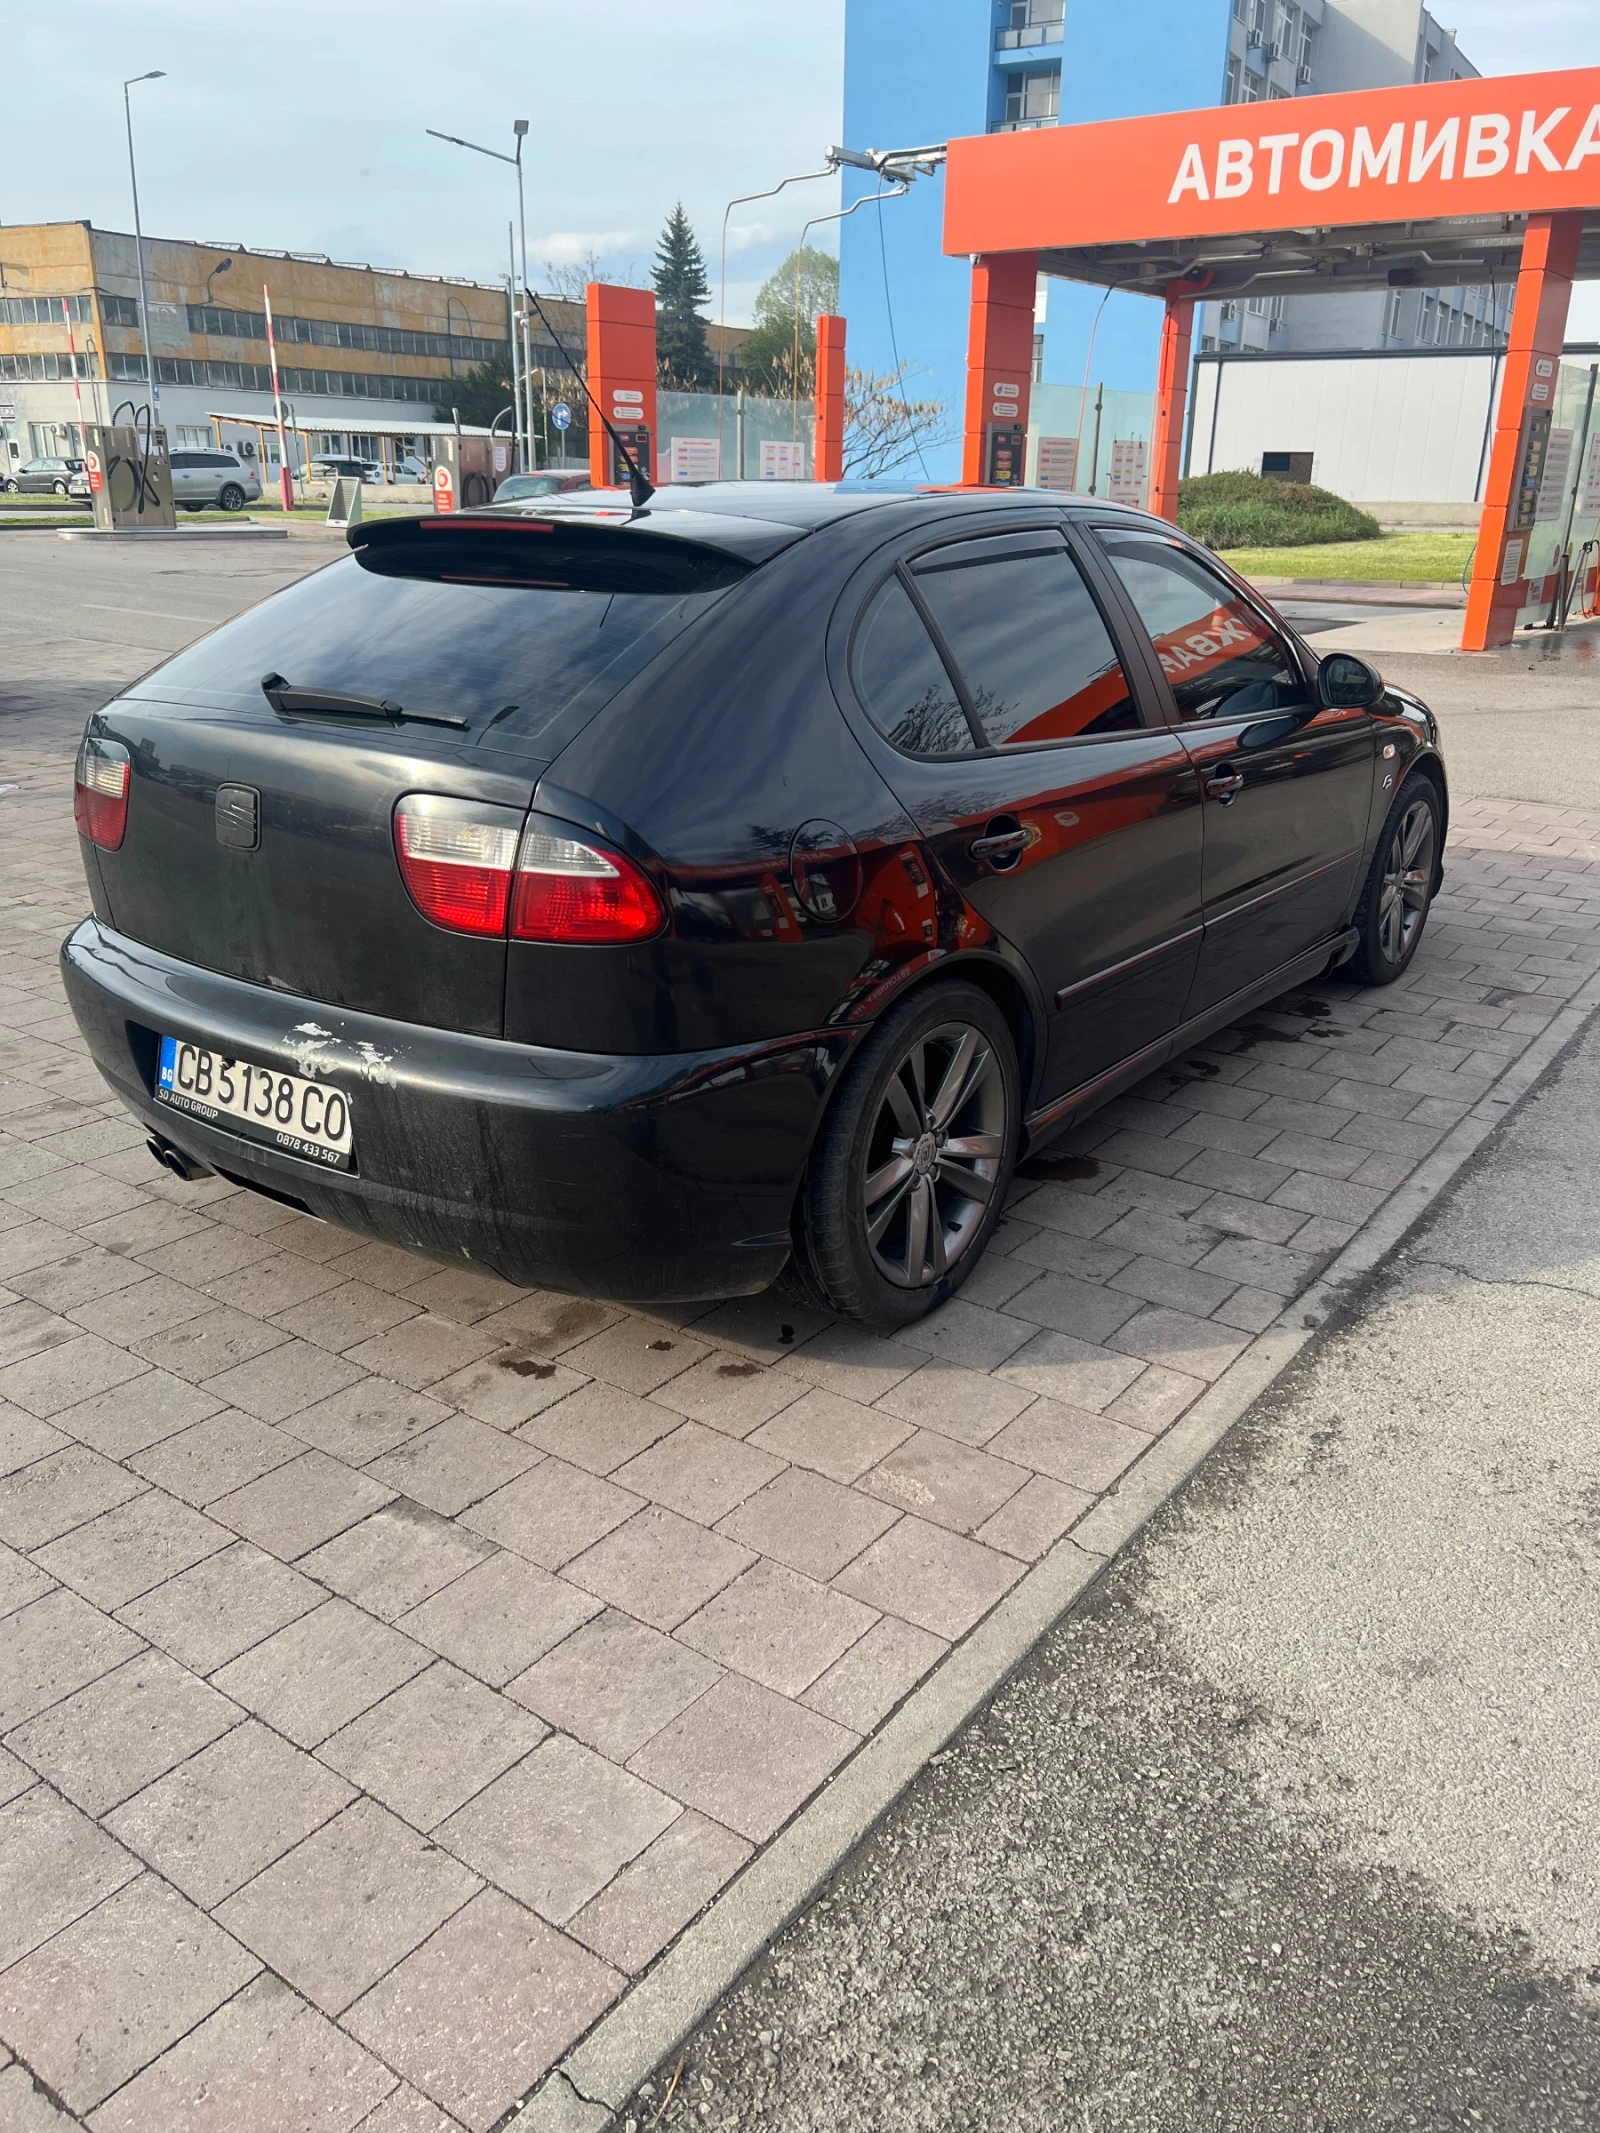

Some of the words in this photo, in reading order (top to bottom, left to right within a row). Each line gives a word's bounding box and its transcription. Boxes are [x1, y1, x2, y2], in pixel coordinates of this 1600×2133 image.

[1167, 104, 1600, 204] АВТОМИВКА
[161, 1066, 173, 1083] BG
[169, 1094, 190, 1109] AUTO
[190, 1101, 218, 1119] GROUP
[276, 1132, 301, 1150] 0878
[302, 1141, 320, 1157] 433
[320, 1147, 341, 1164] 567
